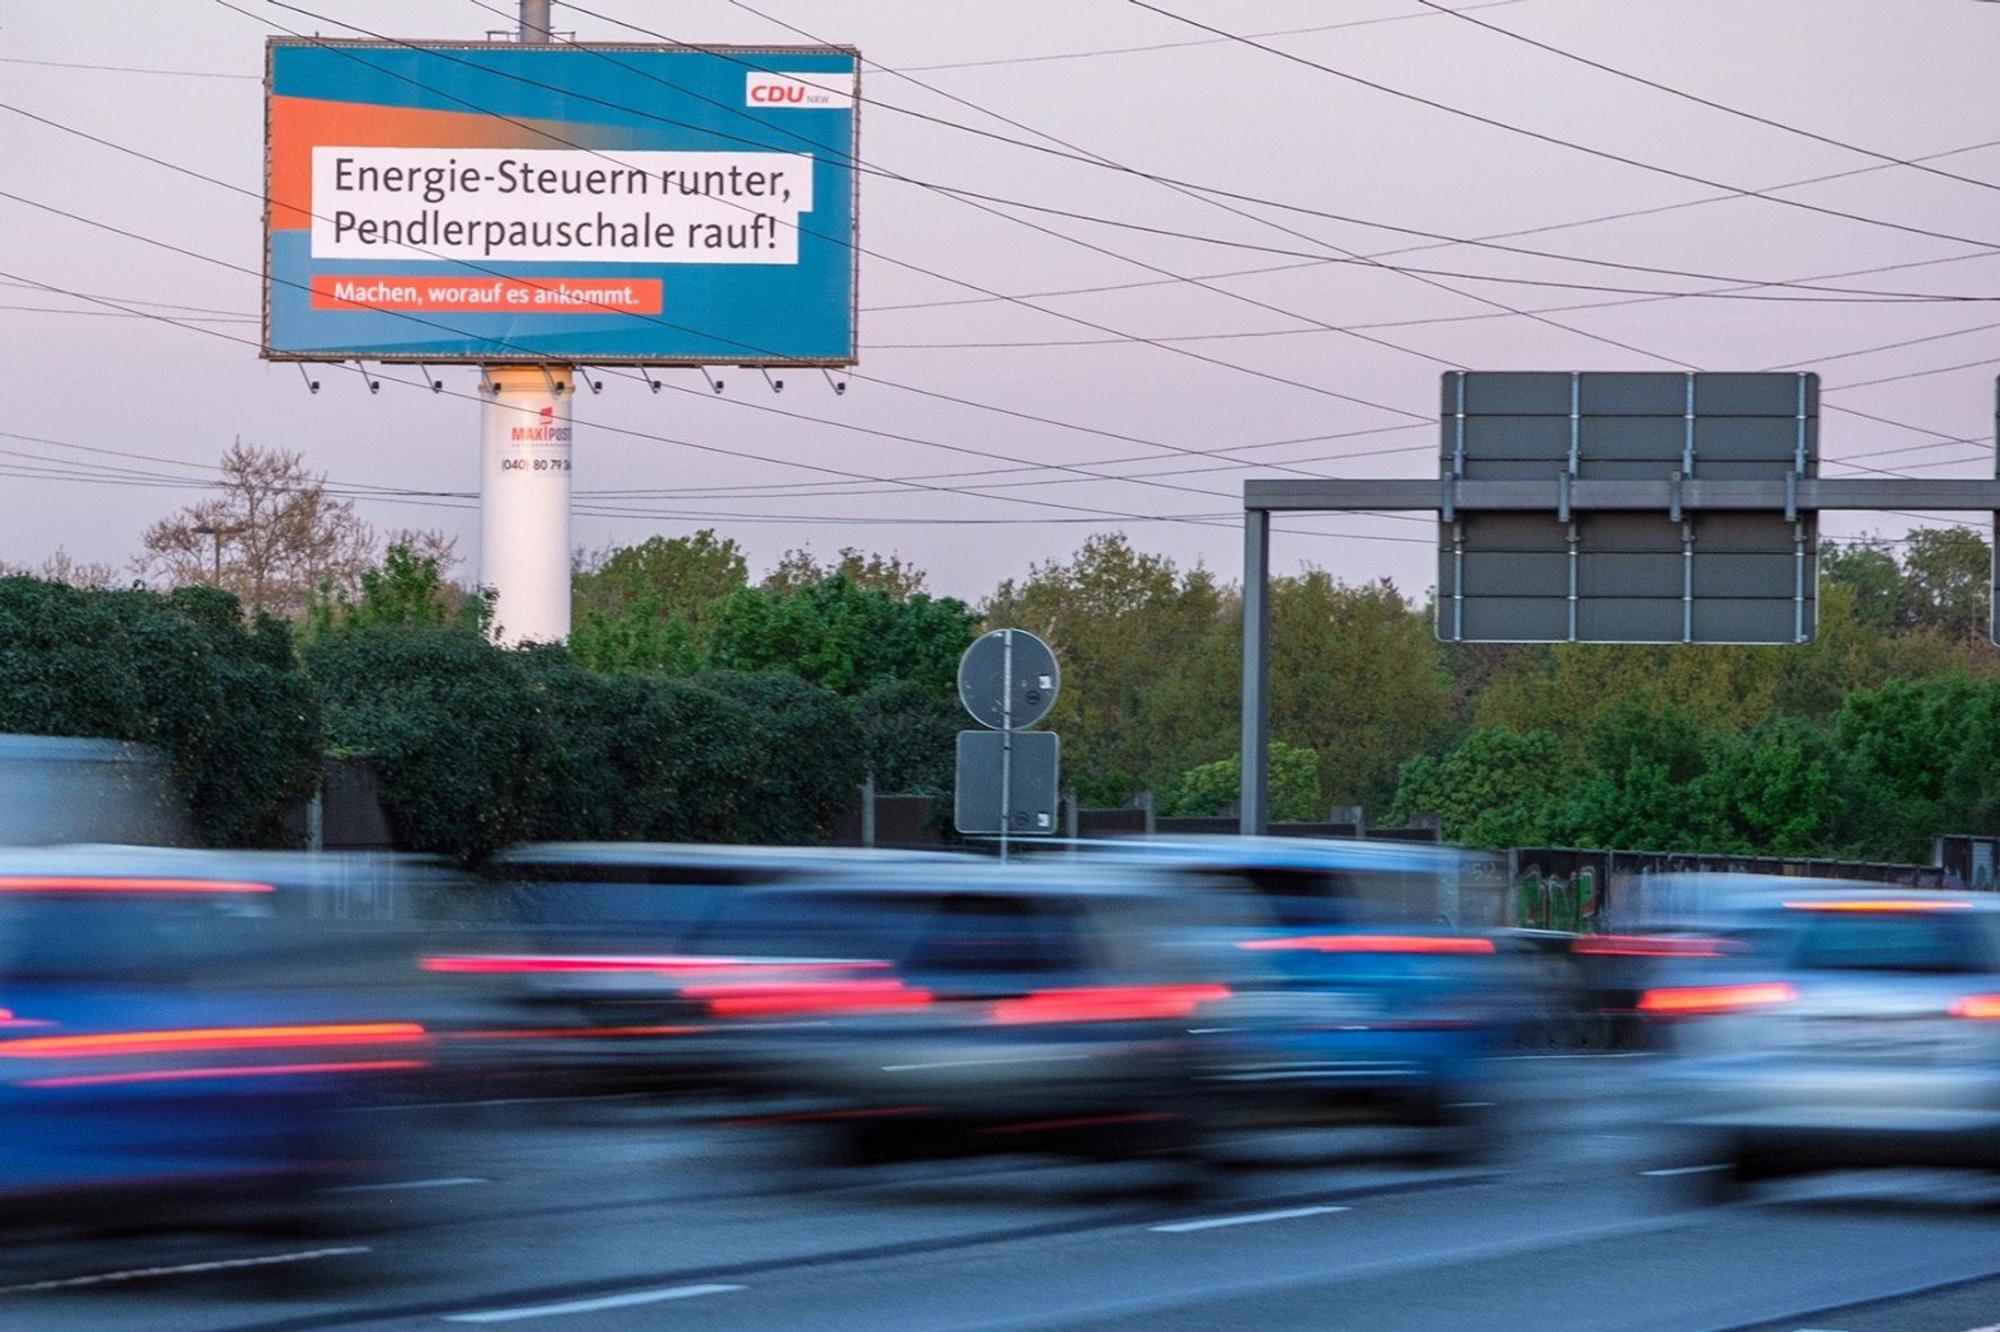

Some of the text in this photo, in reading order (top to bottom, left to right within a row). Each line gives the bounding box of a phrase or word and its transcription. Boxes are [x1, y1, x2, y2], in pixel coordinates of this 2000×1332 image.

[751, 86, 805, 103] CDU
[335, 157, 791, 203] Energie-Steuern runter,
[334, 209, 776, 256] Pendlerpauschale rauf!
[334, 282, 640, 305] Machen, worauf es ankommt.
